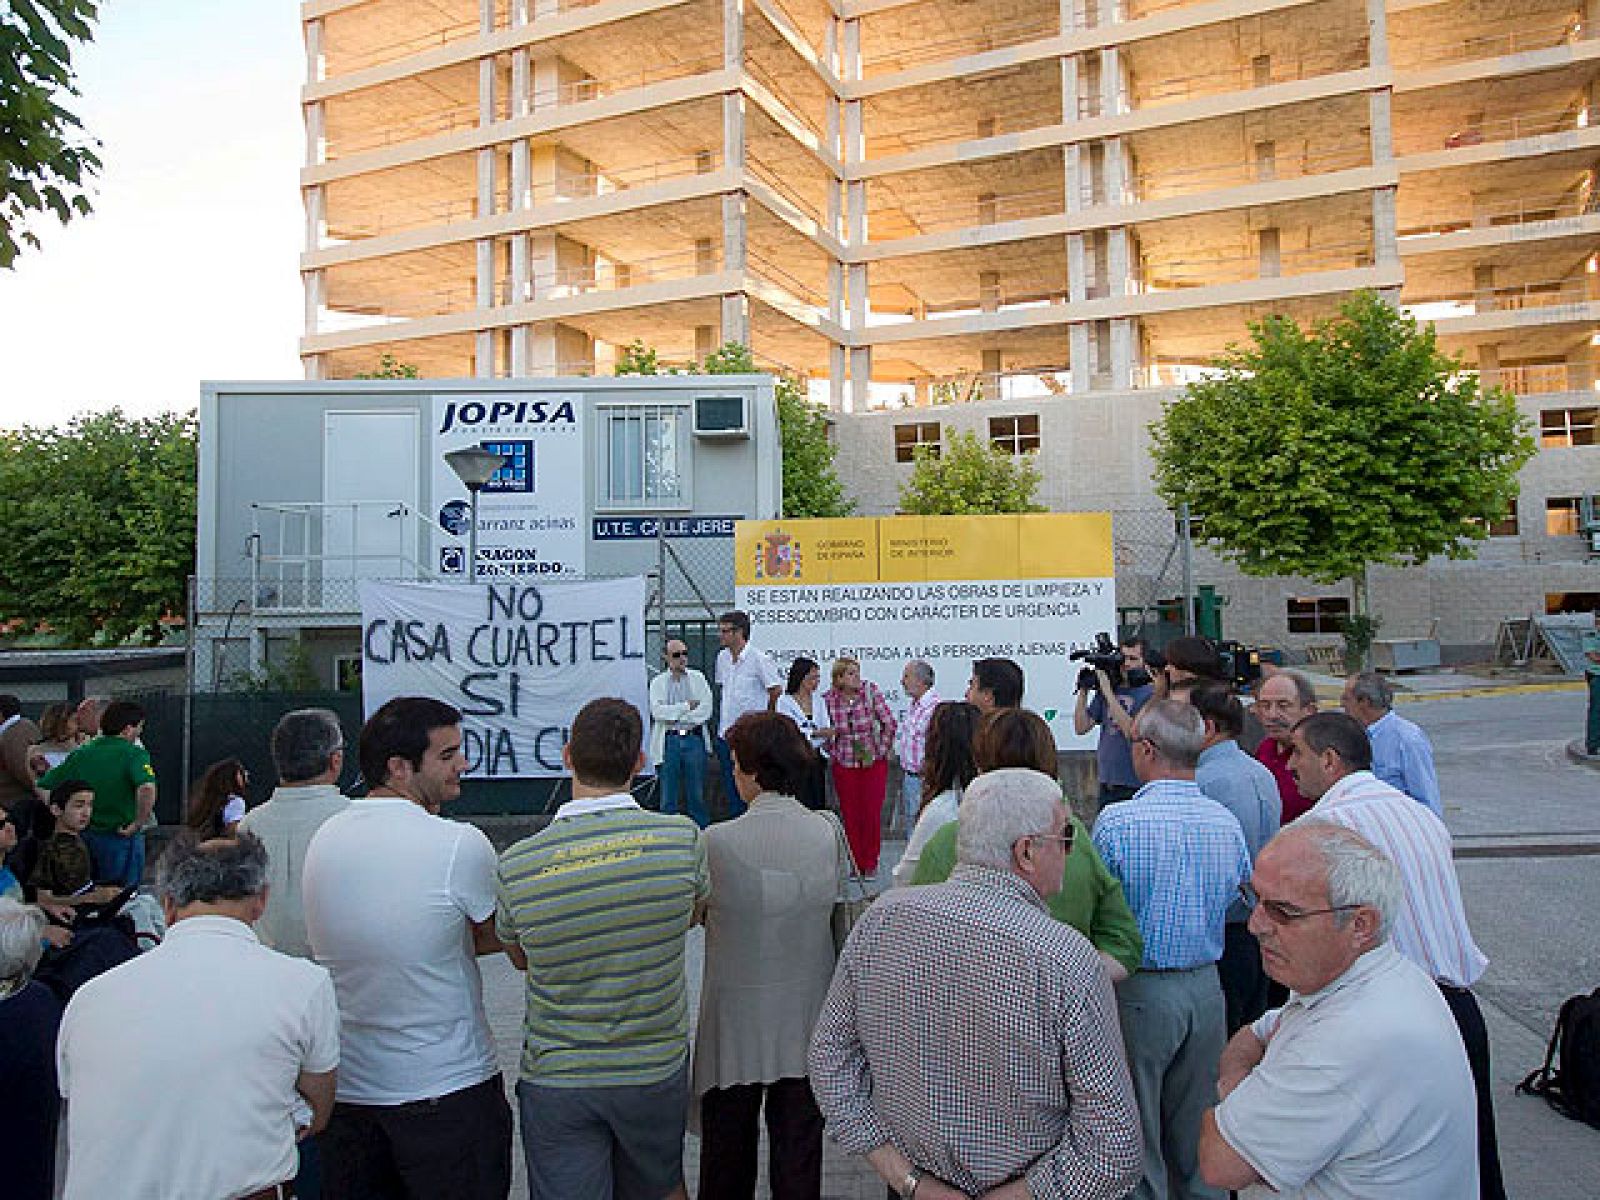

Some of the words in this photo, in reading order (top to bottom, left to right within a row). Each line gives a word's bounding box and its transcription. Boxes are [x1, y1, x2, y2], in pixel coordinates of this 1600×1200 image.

[440, 402, 575, 433] JOPISA
[692, 519, 735, 534] JERE
[487, 584, 543, 621] NO
[747, 589, 765, 604] SE
[822, 586, 913, 601] REALIZANDO
[918, 585, 945, 601] LAS
[949, 584, 998, 600] OBRAS
[1002, 584, 1021, 598] DE
[1027, 582, 1090, 598] LIMPIEZA
[1094, 582, 1103, 596] Y
[865, 606, 898, 621] CON
[982, 604, 1001, 618] DE
[1005, 602, 1081, 618] URGENCIA
[364, 620, 453, 664] CASA
[467, 615, 644, 668] CUARTEL
[905, 646, 913, 658] A
[915, 644, 941, 658] LAS
[944, 643, 1014, 658] PERSONAS
[1017, 642, 1066, 656] AJENAS
[460, 672, 520, 718] SI
[465, 727, 518, 775] DIA
